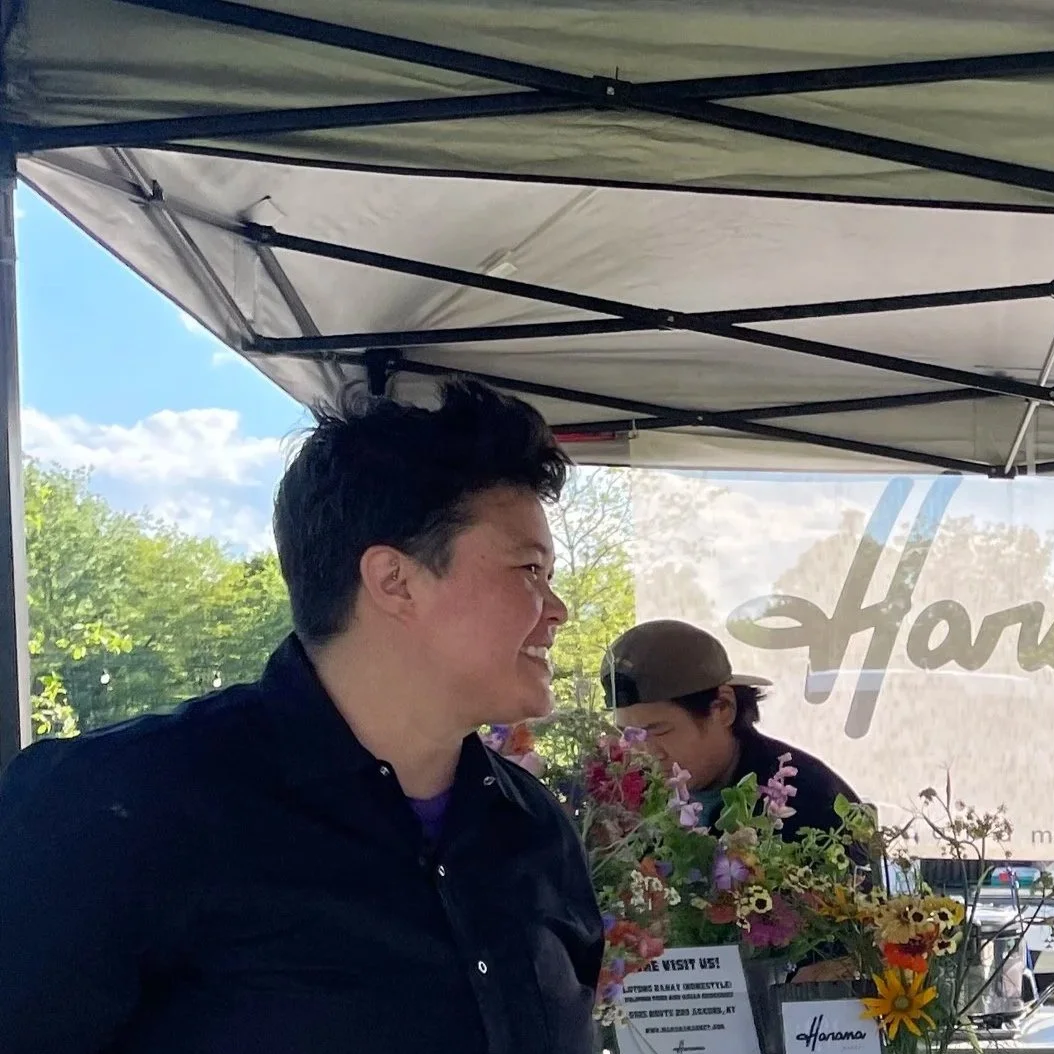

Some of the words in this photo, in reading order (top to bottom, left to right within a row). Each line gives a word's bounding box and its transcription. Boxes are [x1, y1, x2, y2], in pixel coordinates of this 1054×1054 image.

[662, 959, 696, 972] VISIT
[699, 957, 721, 970] US!
[796, 1014, 867, 1052] Harana
